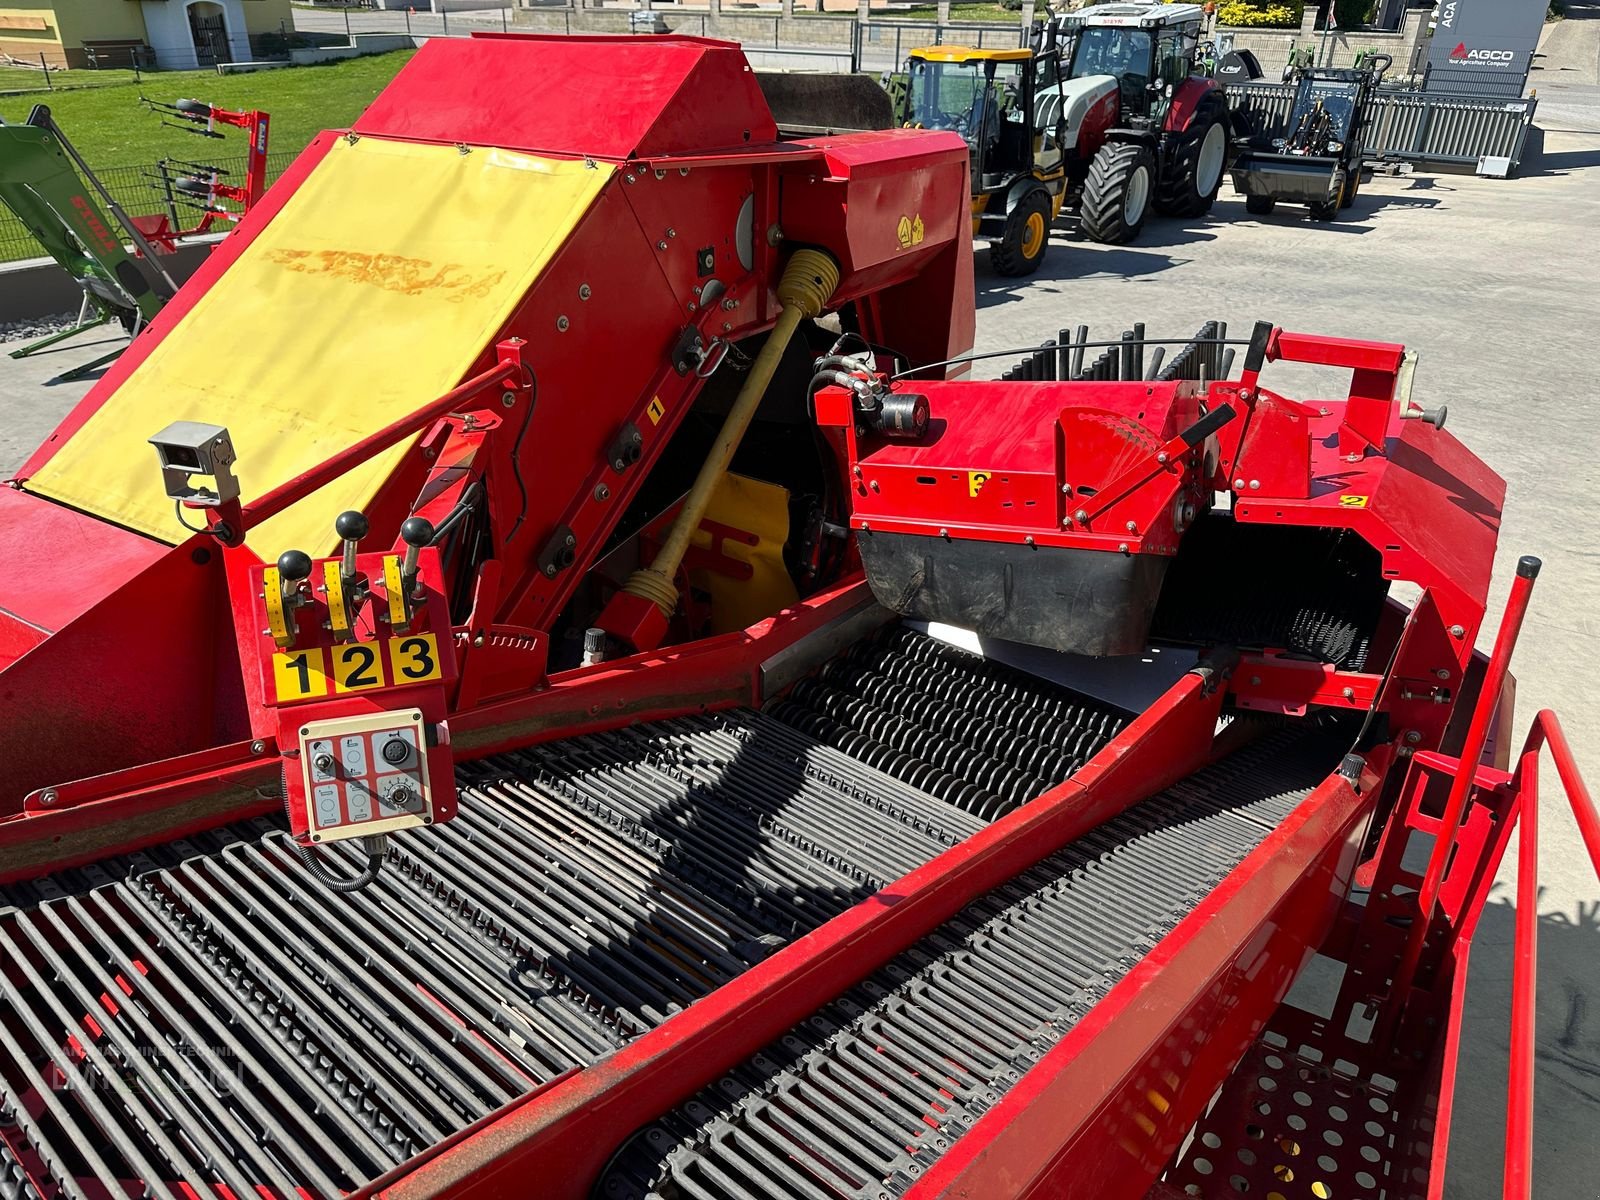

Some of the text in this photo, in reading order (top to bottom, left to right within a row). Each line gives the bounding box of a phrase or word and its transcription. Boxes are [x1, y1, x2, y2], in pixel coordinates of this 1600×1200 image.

[1441, 1, 1457, 28] ACA
[1467, 49, 1514, 61] AGCO
[650, 401, 662, 417] 1
[1345, 496, 1364, 506] 2
[285, 637, 434, 694] 1 2 3
